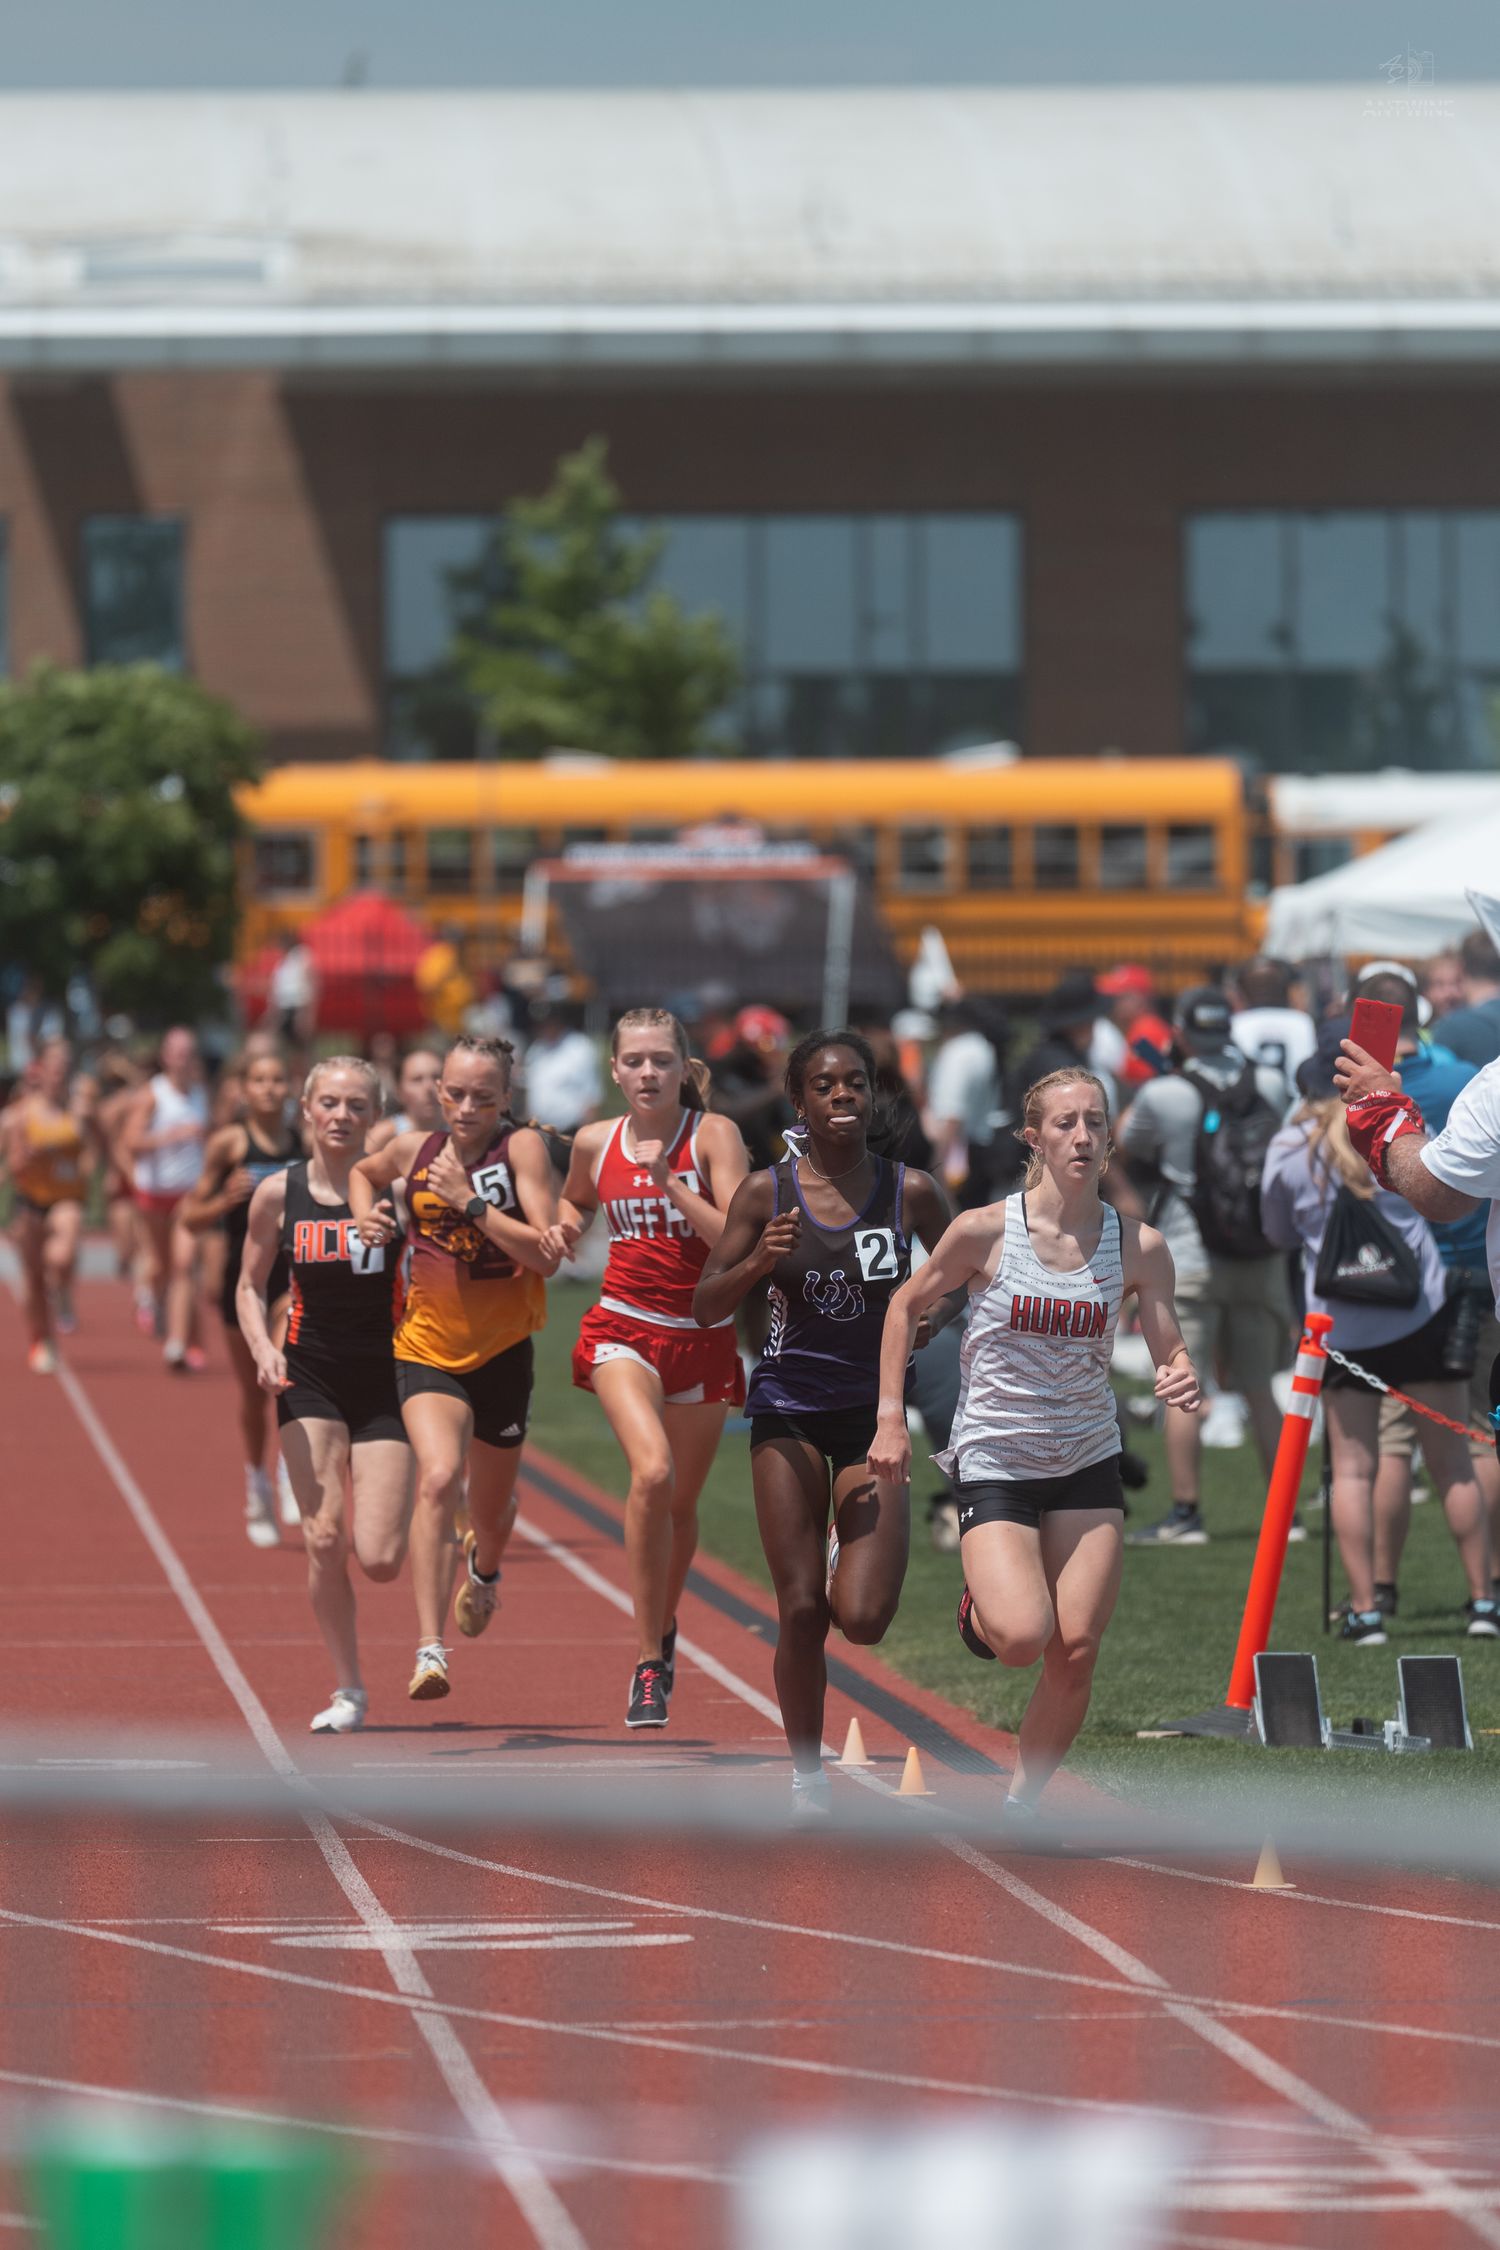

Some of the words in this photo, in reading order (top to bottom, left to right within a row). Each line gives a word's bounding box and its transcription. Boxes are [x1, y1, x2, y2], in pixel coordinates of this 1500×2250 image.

[480, 1169, 507, 1208] 5
[861, 1232, 893, 1277] 2
[1010, 1294, 1109, 1339] HURON
